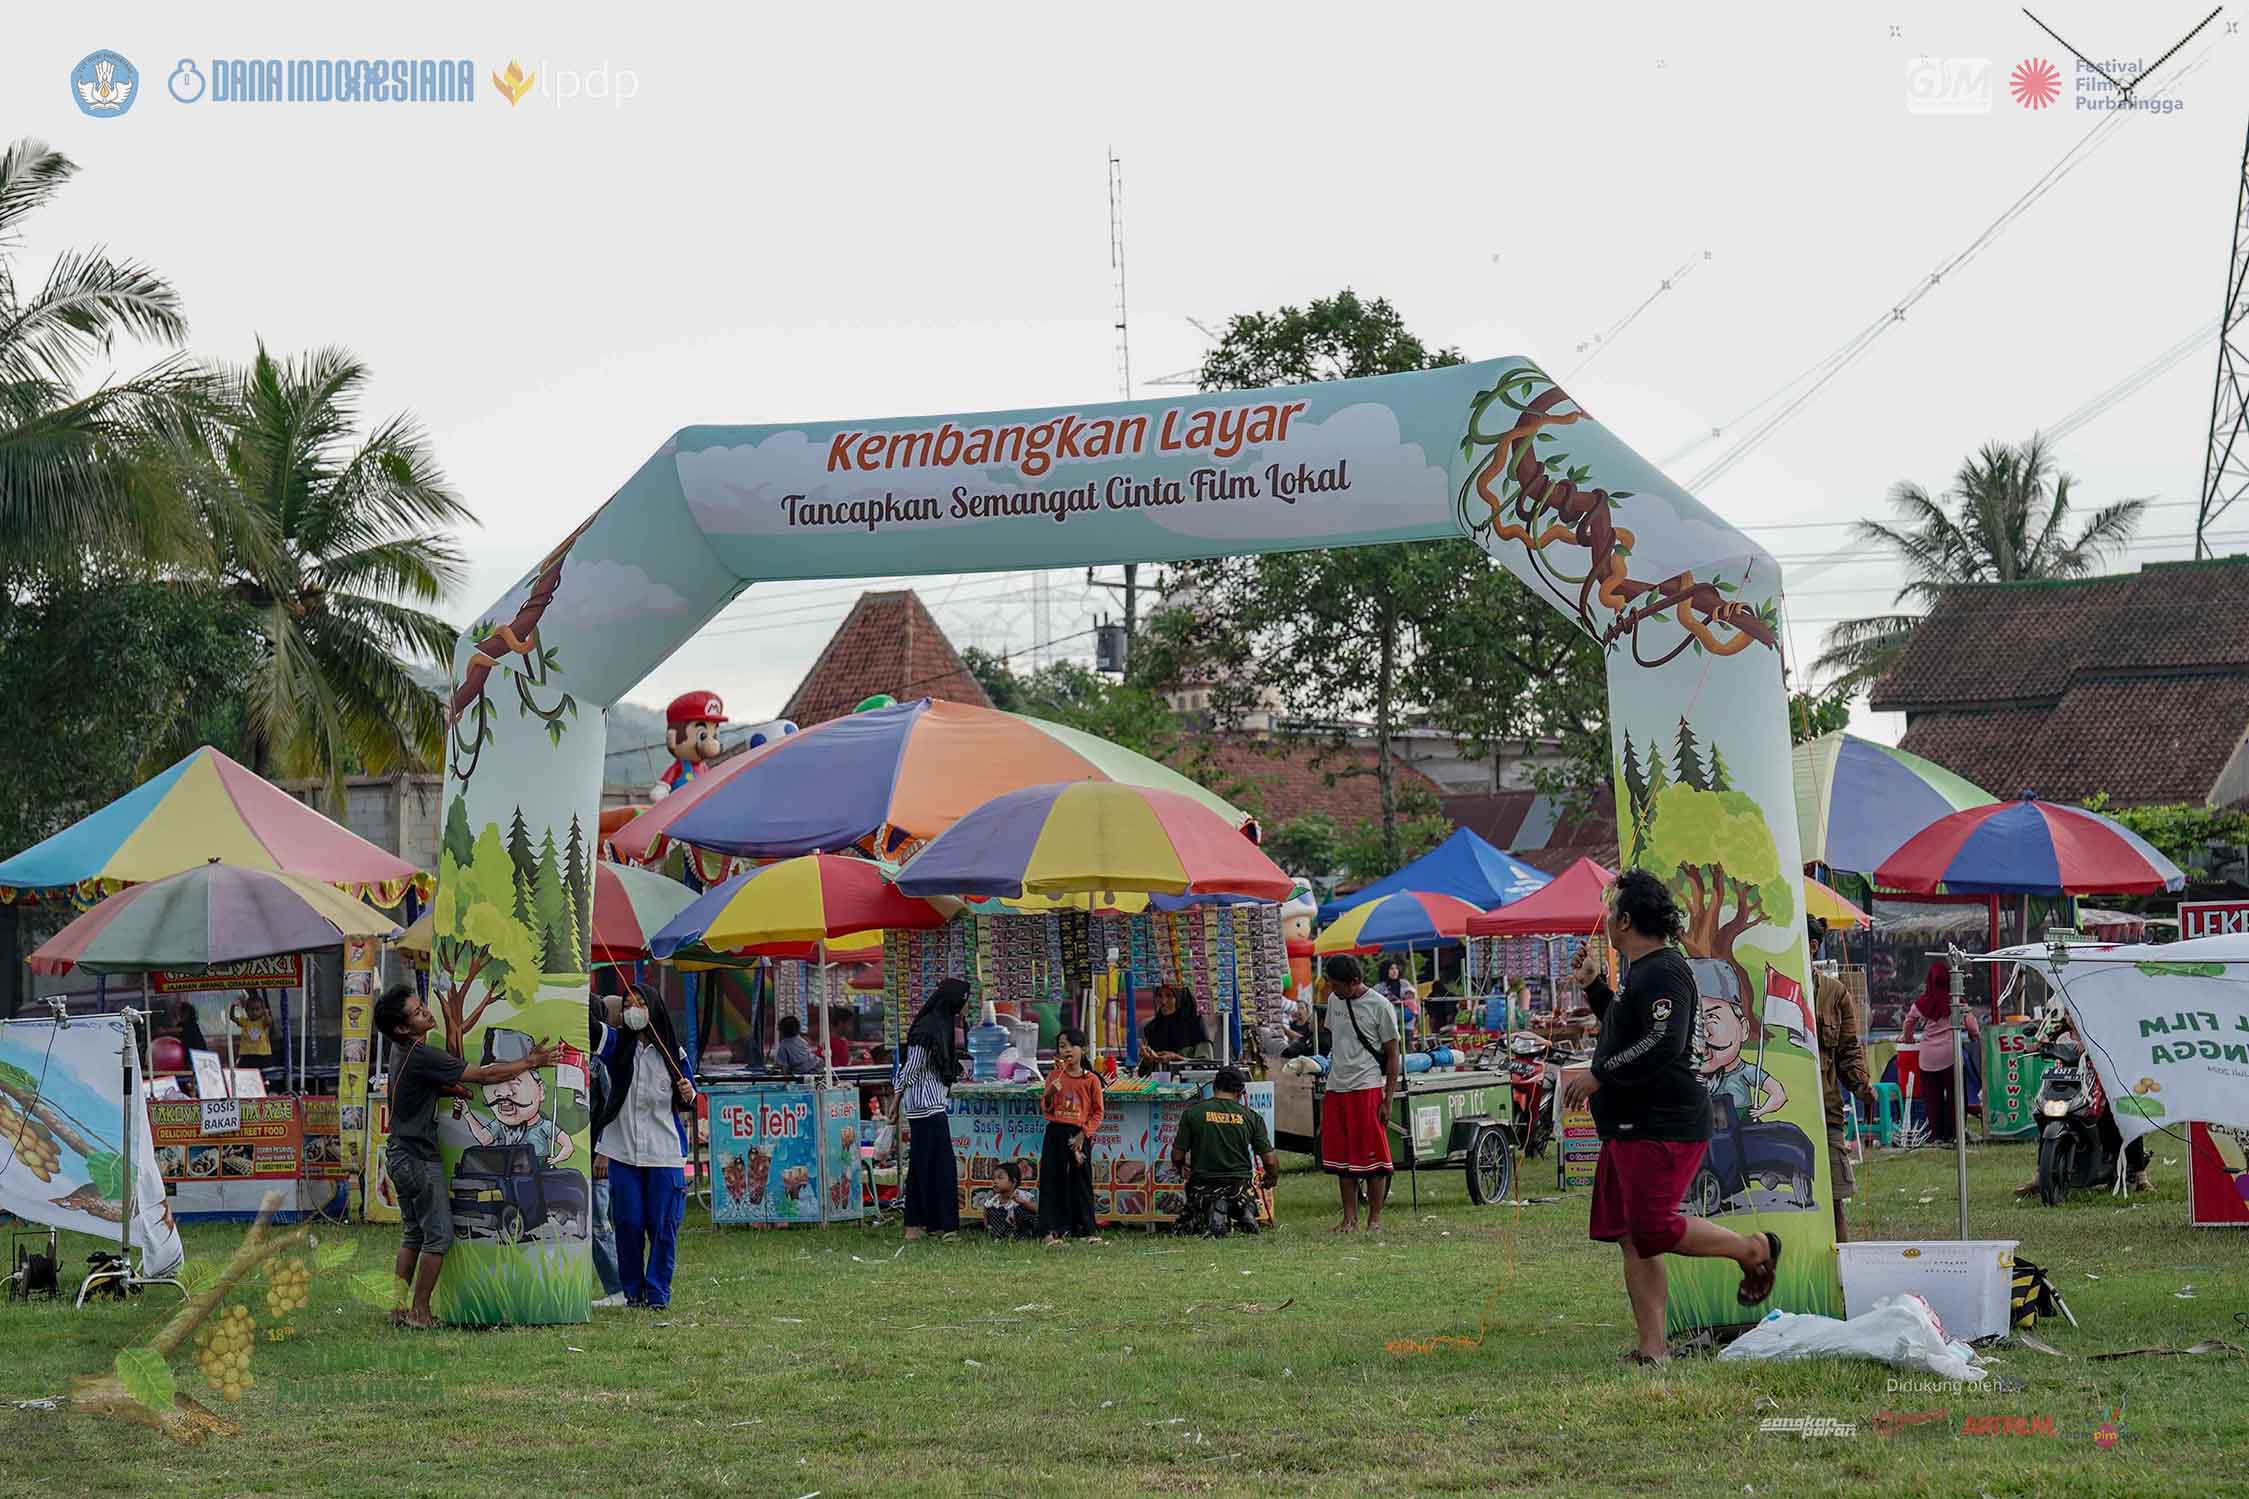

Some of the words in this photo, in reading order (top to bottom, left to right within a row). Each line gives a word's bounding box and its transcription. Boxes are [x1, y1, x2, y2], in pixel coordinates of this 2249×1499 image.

[826, 414, 1145, 477] Kembangkan
[1159, 401, 1306, 458] Layar
[780, 492, 943, 532] Tancapkan
[950, 480, 1100, 524] Semangat
[1105, 474, 1186, 511] Cinta
[1190, 466, 1261, 502] Film
[1264, 459, 1353, 498] Lokal
[1998, 1035, 2026, 1053] ES
[207, 1101, 236, 1114] SOSIS
[1448, 1094, 1466, 1120] POP
[1470, 1089, 1488, 1117] ICE
[204, 1116, 238, 1131] BAKAR
[263, 1125, 285, 1138] FOOD
